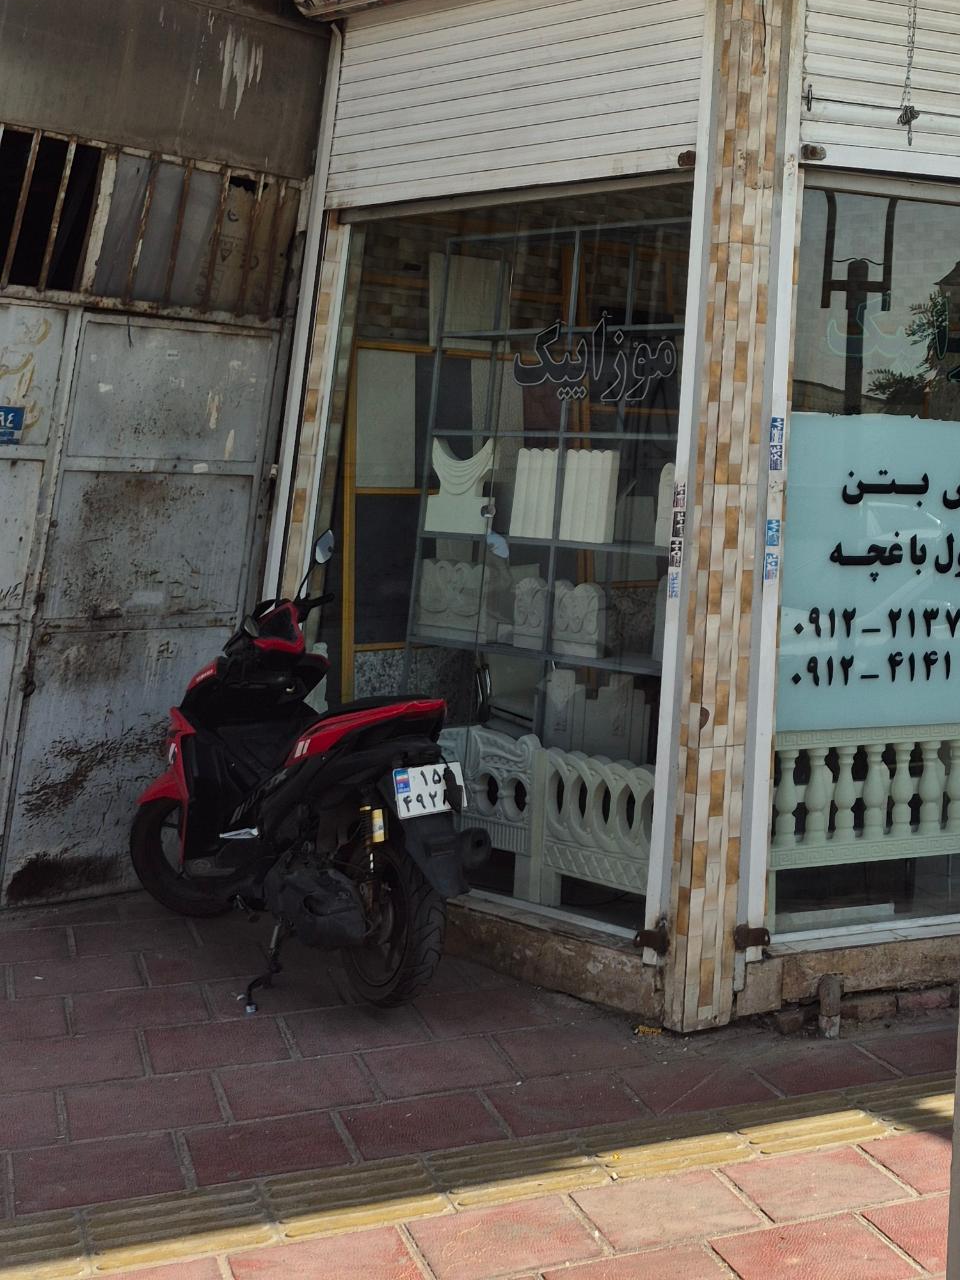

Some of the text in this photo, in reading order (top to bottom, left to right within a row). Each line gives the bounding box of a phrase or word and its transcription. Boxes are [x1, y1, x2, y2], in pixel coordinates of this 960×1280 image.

[512, 314, 678, 403] موزاییک
[841, 470, 930, 506] بتن
[829, 530, 928, 583] باغچه
